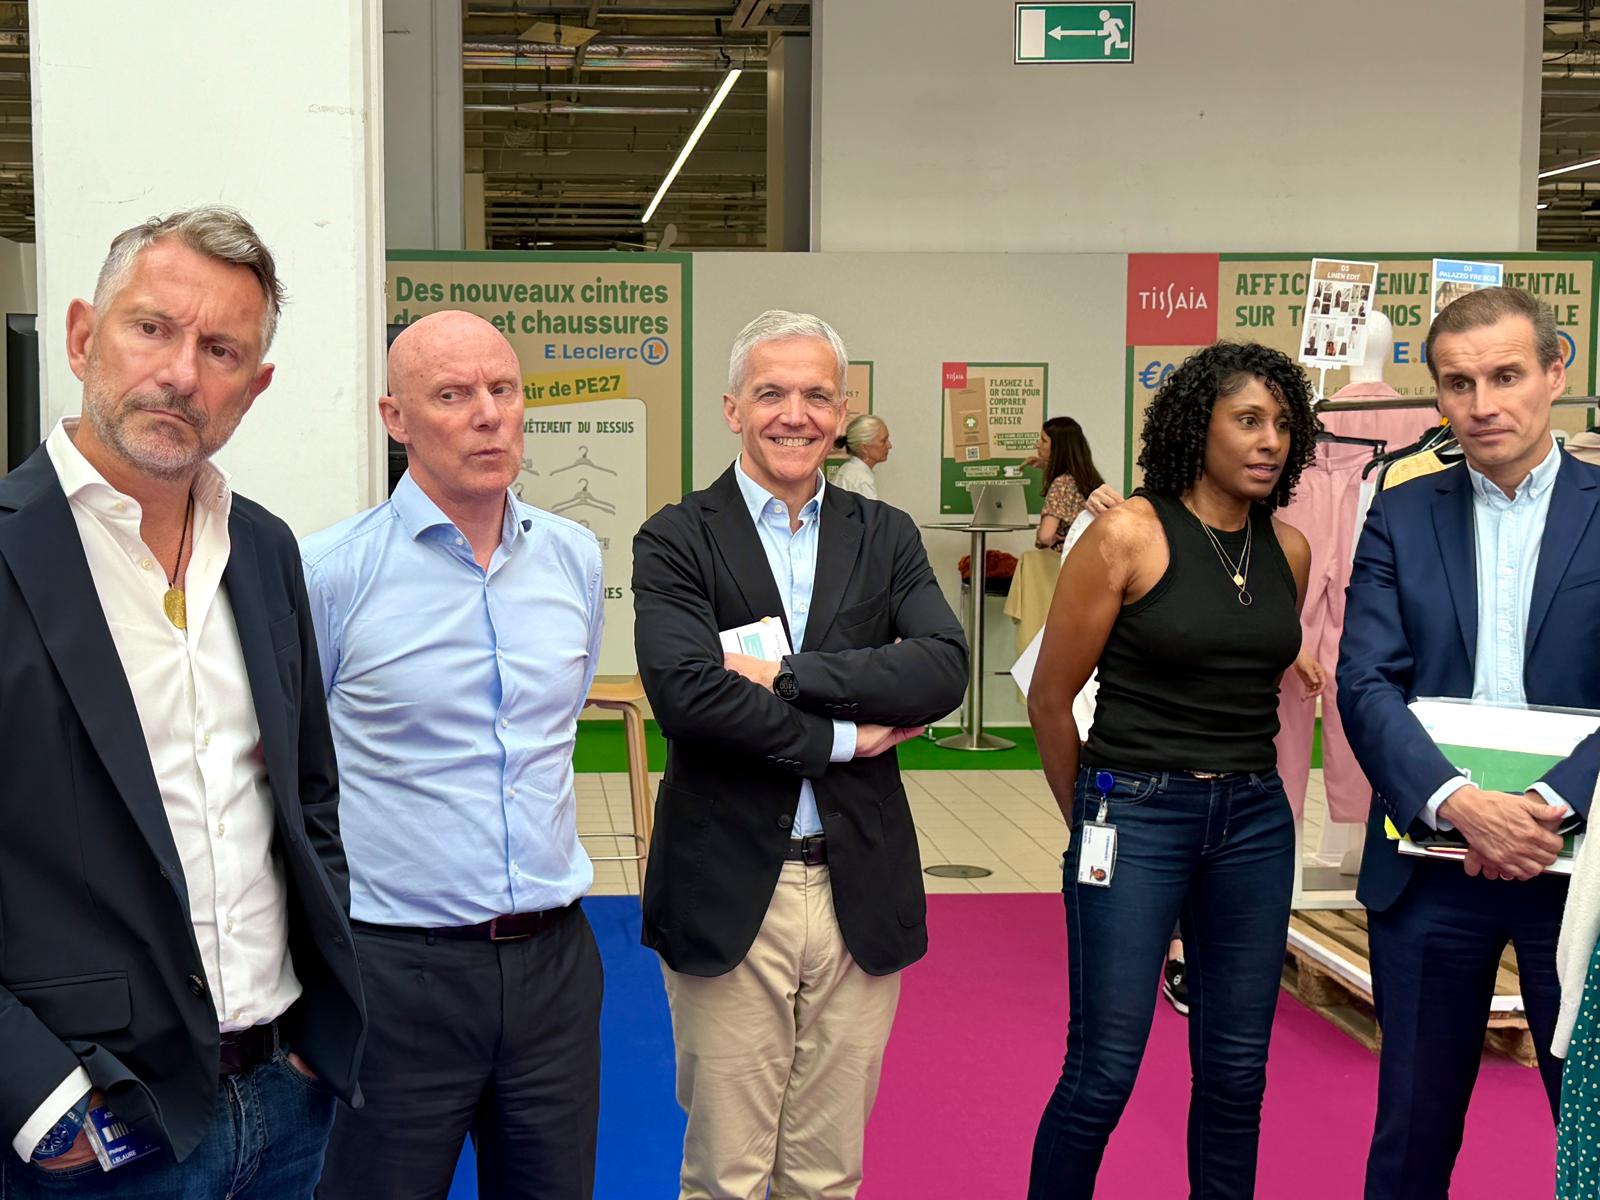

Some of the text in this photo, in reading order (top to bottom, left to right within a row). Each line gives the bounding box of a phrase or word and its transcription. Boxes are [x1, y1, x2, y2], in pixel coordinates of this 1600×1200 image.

[396, 276, 669, 303] Des nouveaux cintres
[1236, 273, 1311, 295] AFFIC
[491, 309, 669, 334] et chaussures
[1235, 305, 1275, 327] SUR
[544, 344, 638, 360] E.Leclerc
[549, 380, 572, 398] de
[575, 375, 622, 396] PE27
[990, 379, 1034, 387] FLASHEZ LE
[1001, 388, 1020, 396] CODE
[1022, 388, 1041, 396] POUR
[989, 398, 1027, 406] COMPARER
[989, 407, 1024, 415] ET MIEUX
[578, 421, 591, 433] DU
[597, 421, 634, 433] DESSUS
[989, 417, 1022, 425] CHOISIR
